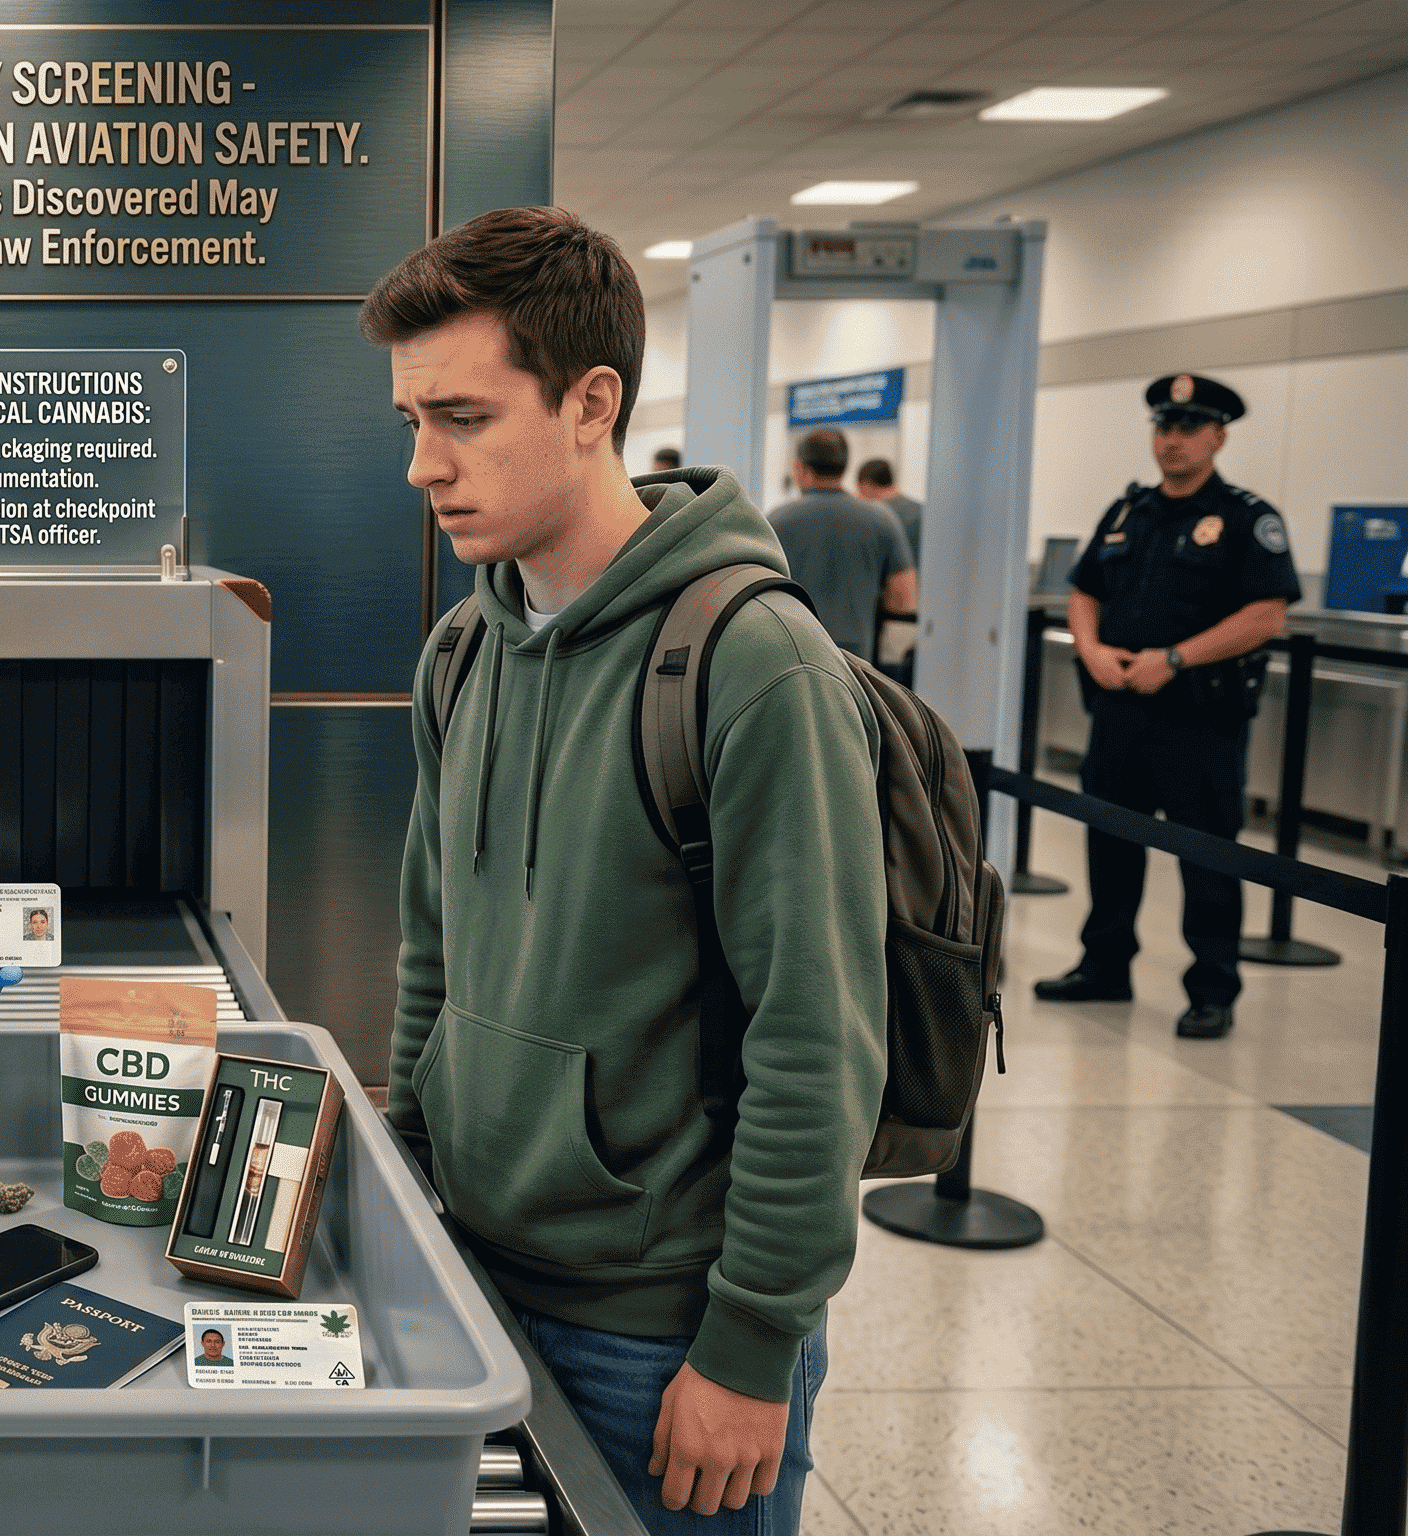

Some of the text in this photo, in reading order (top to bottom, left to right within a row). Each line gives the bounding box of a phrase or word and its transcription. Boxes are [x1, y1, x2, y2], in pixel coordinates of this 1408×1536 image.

[12, 61, 231, 104] SCREENING
[25, 122, 203, 165] AVIATION
[215, 122, 369, 164] SAFETY.
[13, 179, 197, 215] Discovered
[209, 180, 278, 223] May
[42, 228, 266, 265] Enforcement.
[38, 401, 151, 424] CANNABIS:
[76, 438, 157, 462] required.
[32, 499, 51, 519] at
[56, 498, 156, 523] checkpoint
[38, 524, 101, 545] officer.
[96, 1048, 170, 1080] CBD
[250, 1069, 293, 1091] THC
[84, 1085, 180, 1112] GUMMIES
[60, 1298, 145, 1332] PASSPORT
